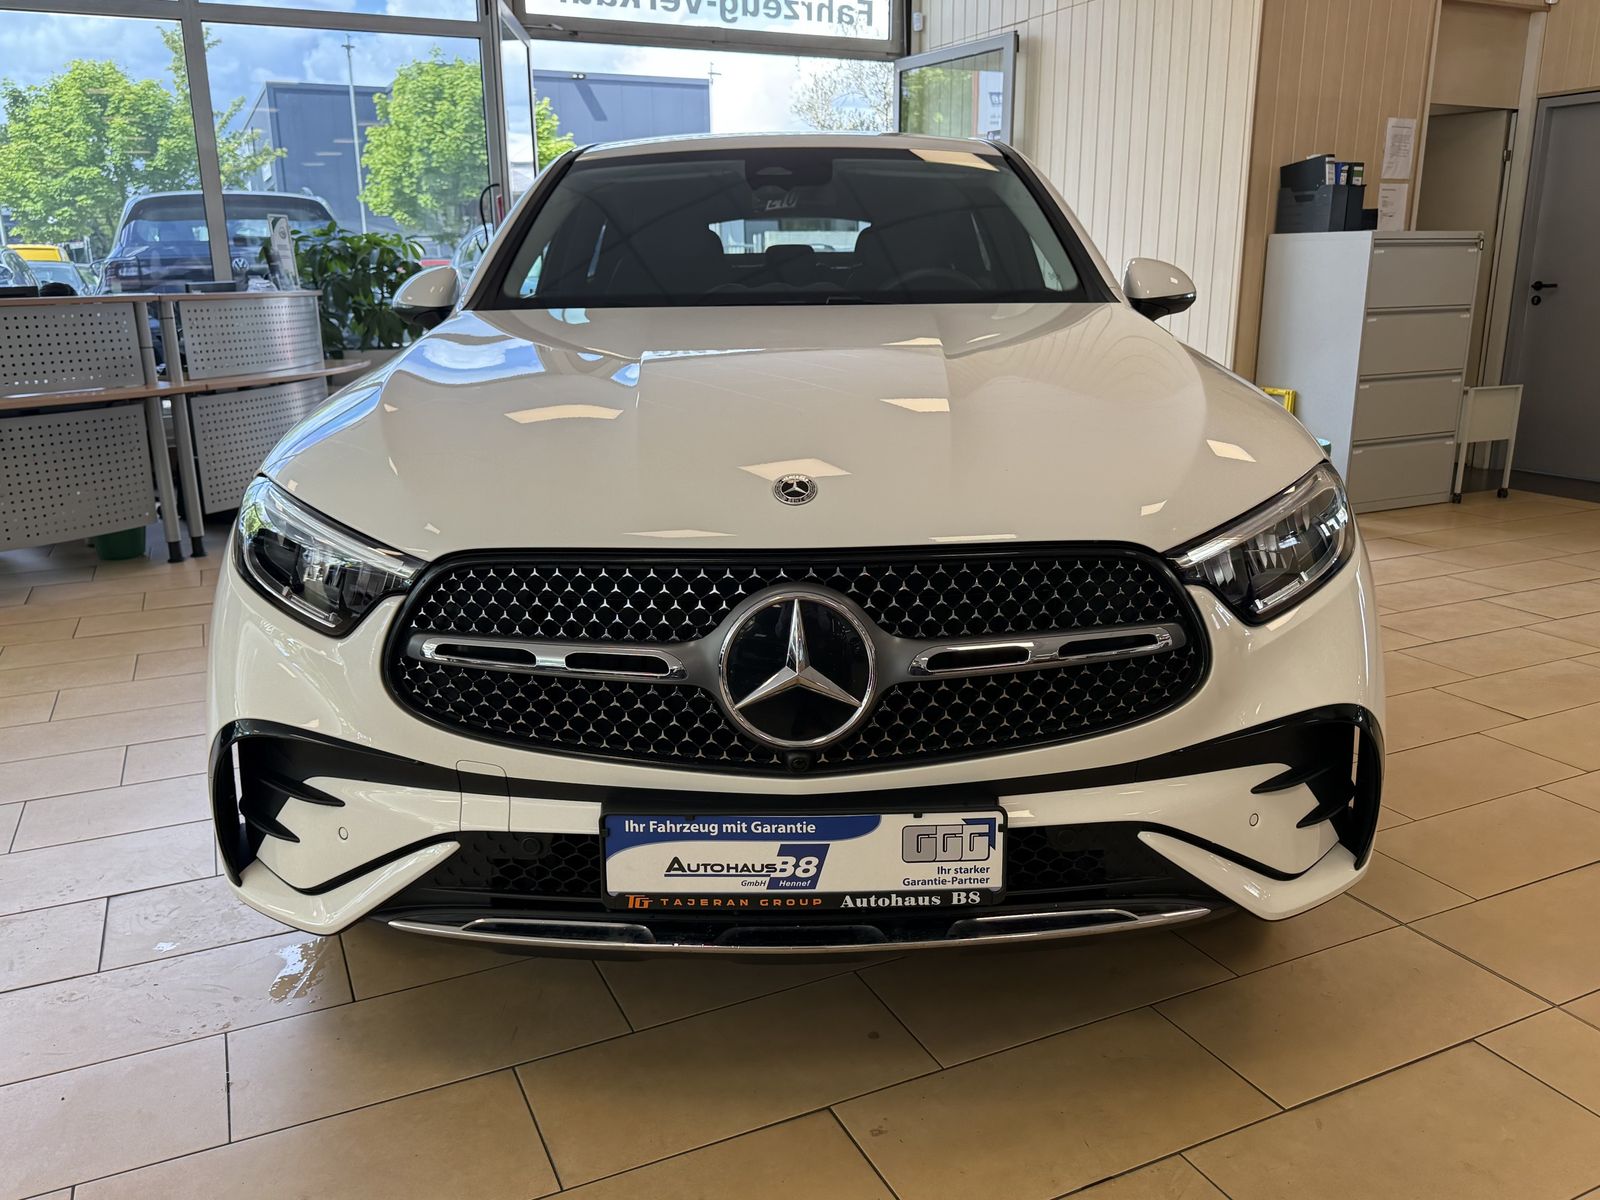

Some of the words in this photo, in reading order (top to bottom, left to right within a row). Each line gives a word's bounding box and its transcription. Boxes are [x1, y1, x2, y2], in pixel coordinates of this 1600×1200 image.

[625, 820, 646, 833] Ihr
[649, 820, 718, 836] Fahrzeug
[722, 821, 748, 834] mit
[751, 821, 816, 834] Garantie
[937, 866, 951, 875] Ihr
[954, 865, 990, 875] starker
[741, 879, 767, 888] GmbH
[779, 879, 811, 887] Hennef
[902, 876, 990, 887] Garantie-Partner
[661, 898, 749, 907] TAJERAN
[760, 898, 822, 907] GROUP
[840, 893, 941, 908] Autohaus
[952, 891, 981, 905] B8
